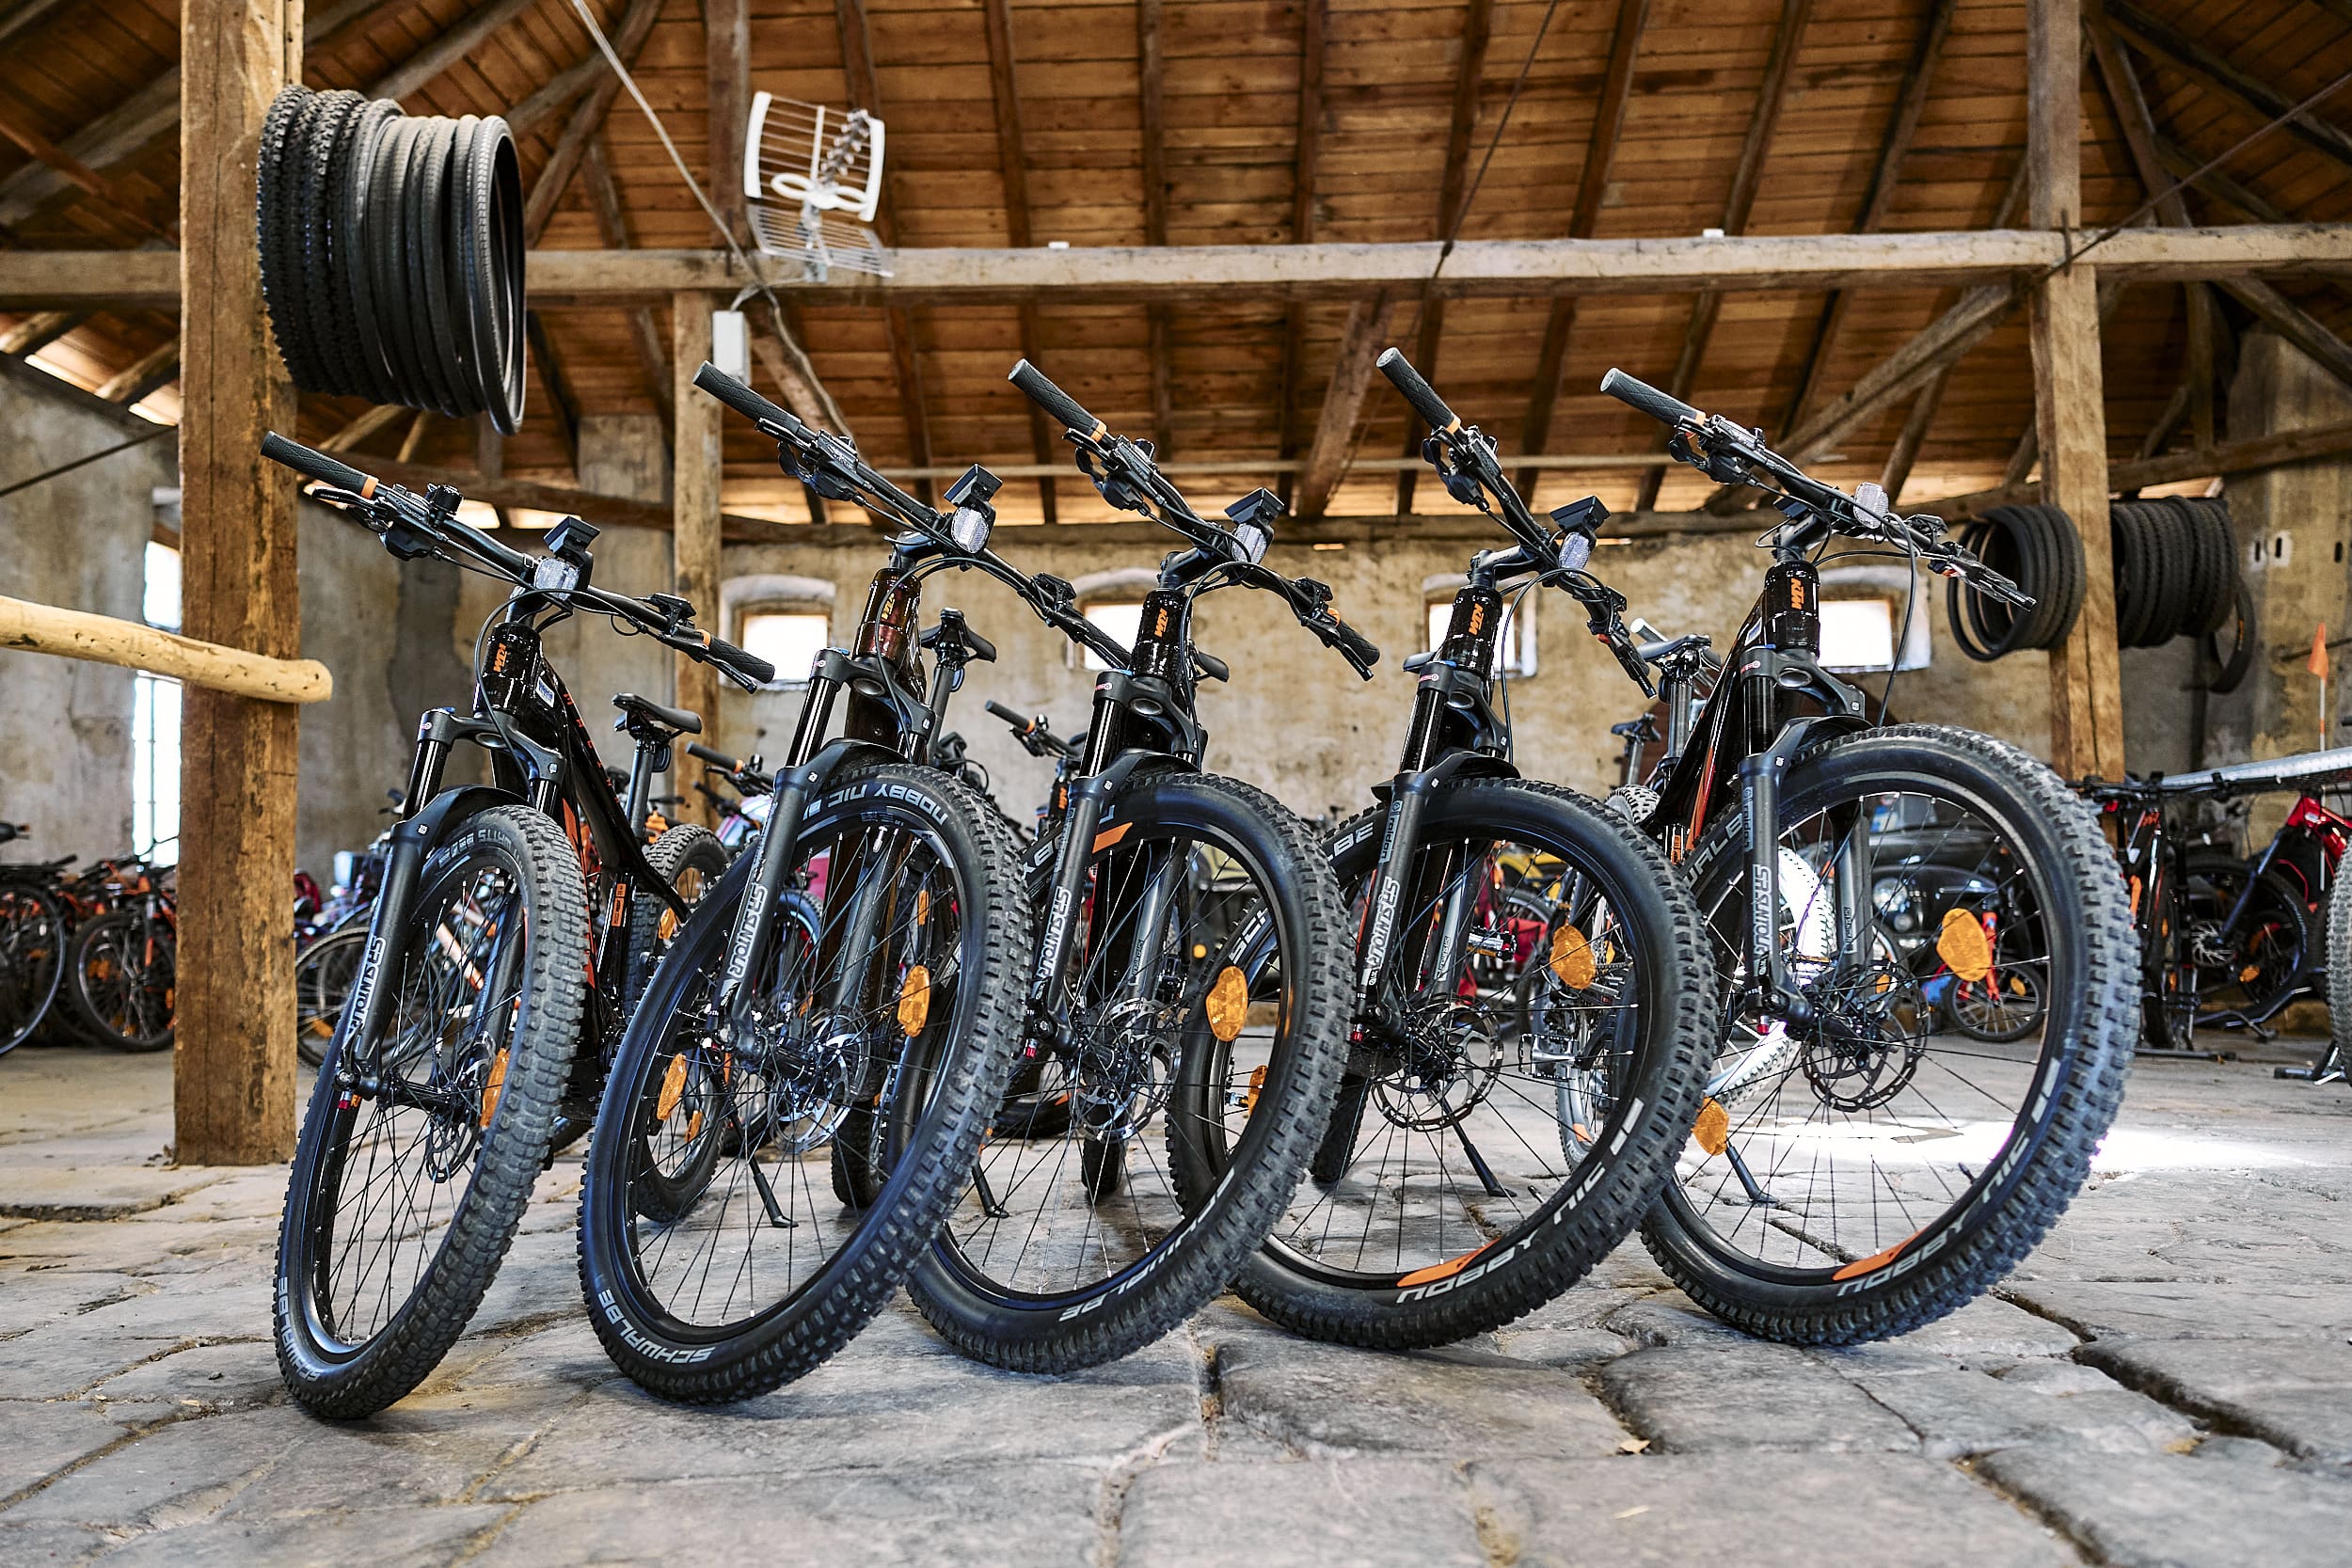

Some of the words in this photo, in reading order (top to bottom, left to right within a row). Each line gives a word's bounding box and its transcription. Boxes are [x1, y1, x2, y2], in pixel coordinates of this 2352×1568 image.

[1791, 577, 1804, 610] KTM
[1154, 608, 1168, 638] KTM
[1469, 603, 1484, 636] KTM
[493, 642, 507, 673] KTM
[828, 784, 867, 807] NIC
[874, 784, 949, 826] NOBBY
[1380, 817, 1395, 859] raidon
[1396, 1228, 1540, 1304] NOBBY
[1554, 1162, 1605, 1225] NIC
[1837, 1209, 1969, 1296] NOBBY
[1982, 1132, 2029, 1204] NIC
[278, 1277, 325, 1381] SCHWALBE
[598, 1289, 715, 1364] SCHWALBE
